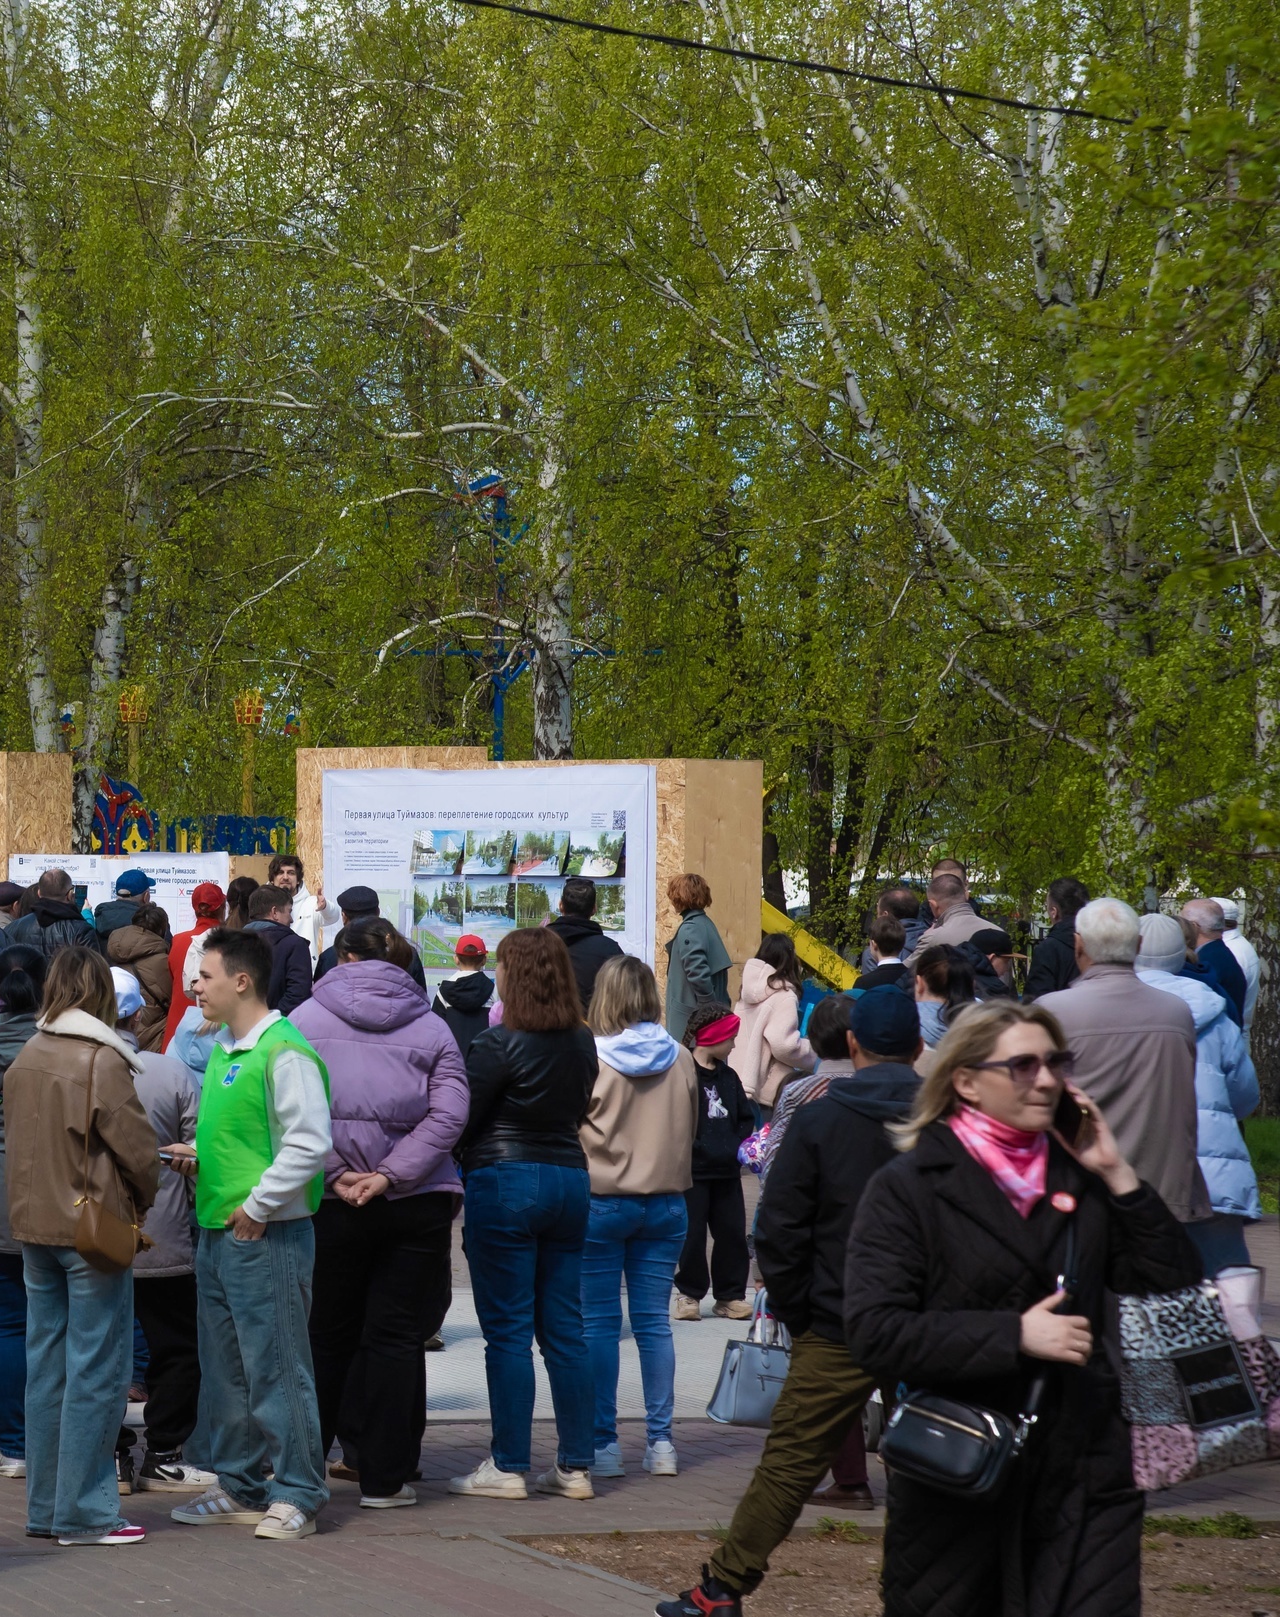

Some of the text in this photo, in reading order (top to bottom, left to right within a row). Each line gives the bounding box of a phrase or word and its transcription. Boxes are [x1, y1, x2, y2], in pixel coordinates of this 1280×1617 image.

[344, 810, 569, 821] Первая улица Туймазов: переплетение городских культур
[172, 867, 197, 875] Туймазов:
